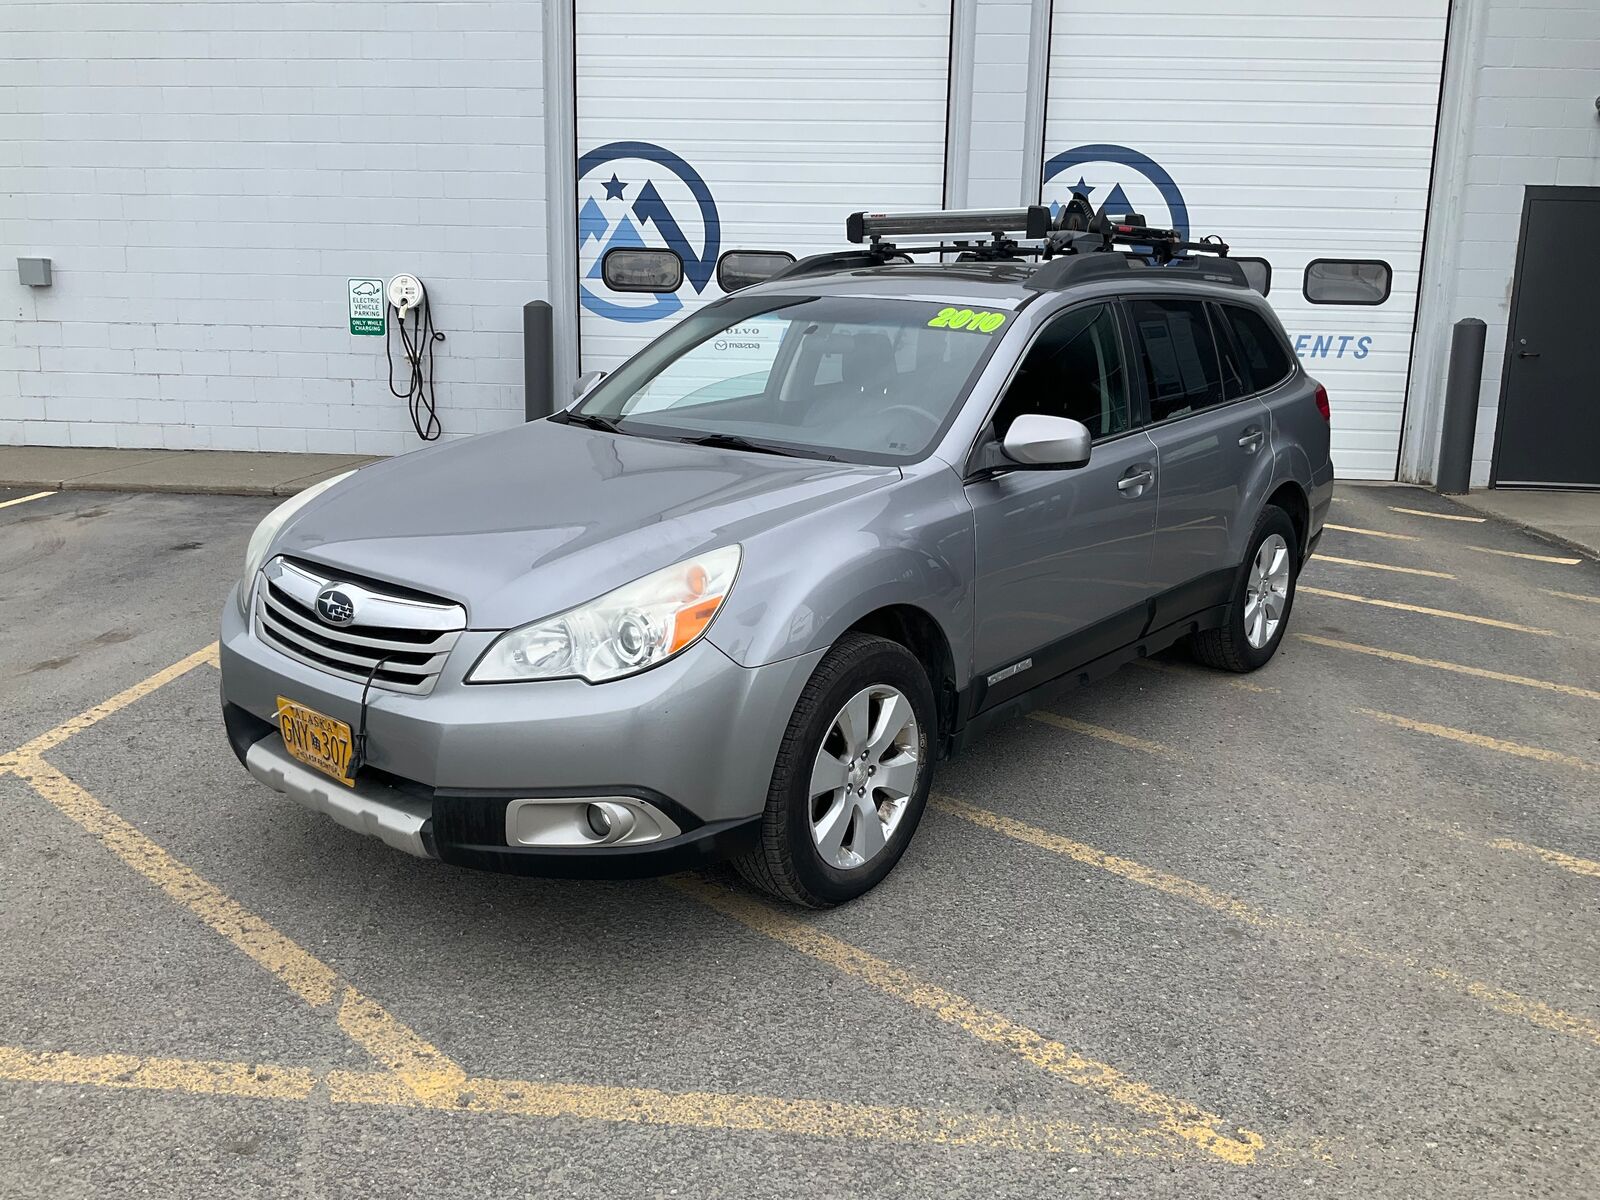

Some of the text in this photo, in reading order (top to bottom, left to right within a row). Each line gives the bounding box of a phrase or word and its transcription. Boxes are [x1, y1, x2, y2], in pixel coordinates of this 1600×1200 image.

[725, 327, 760, 335] OLVO
[928, 307, 1006, 333] 2010
[1288, 334, 1373, 360] ENTS
[294, 709, 333, 733] ALASKA
[281, 714, 309, 752] GNY
[321, 731, 348, 770] 307
